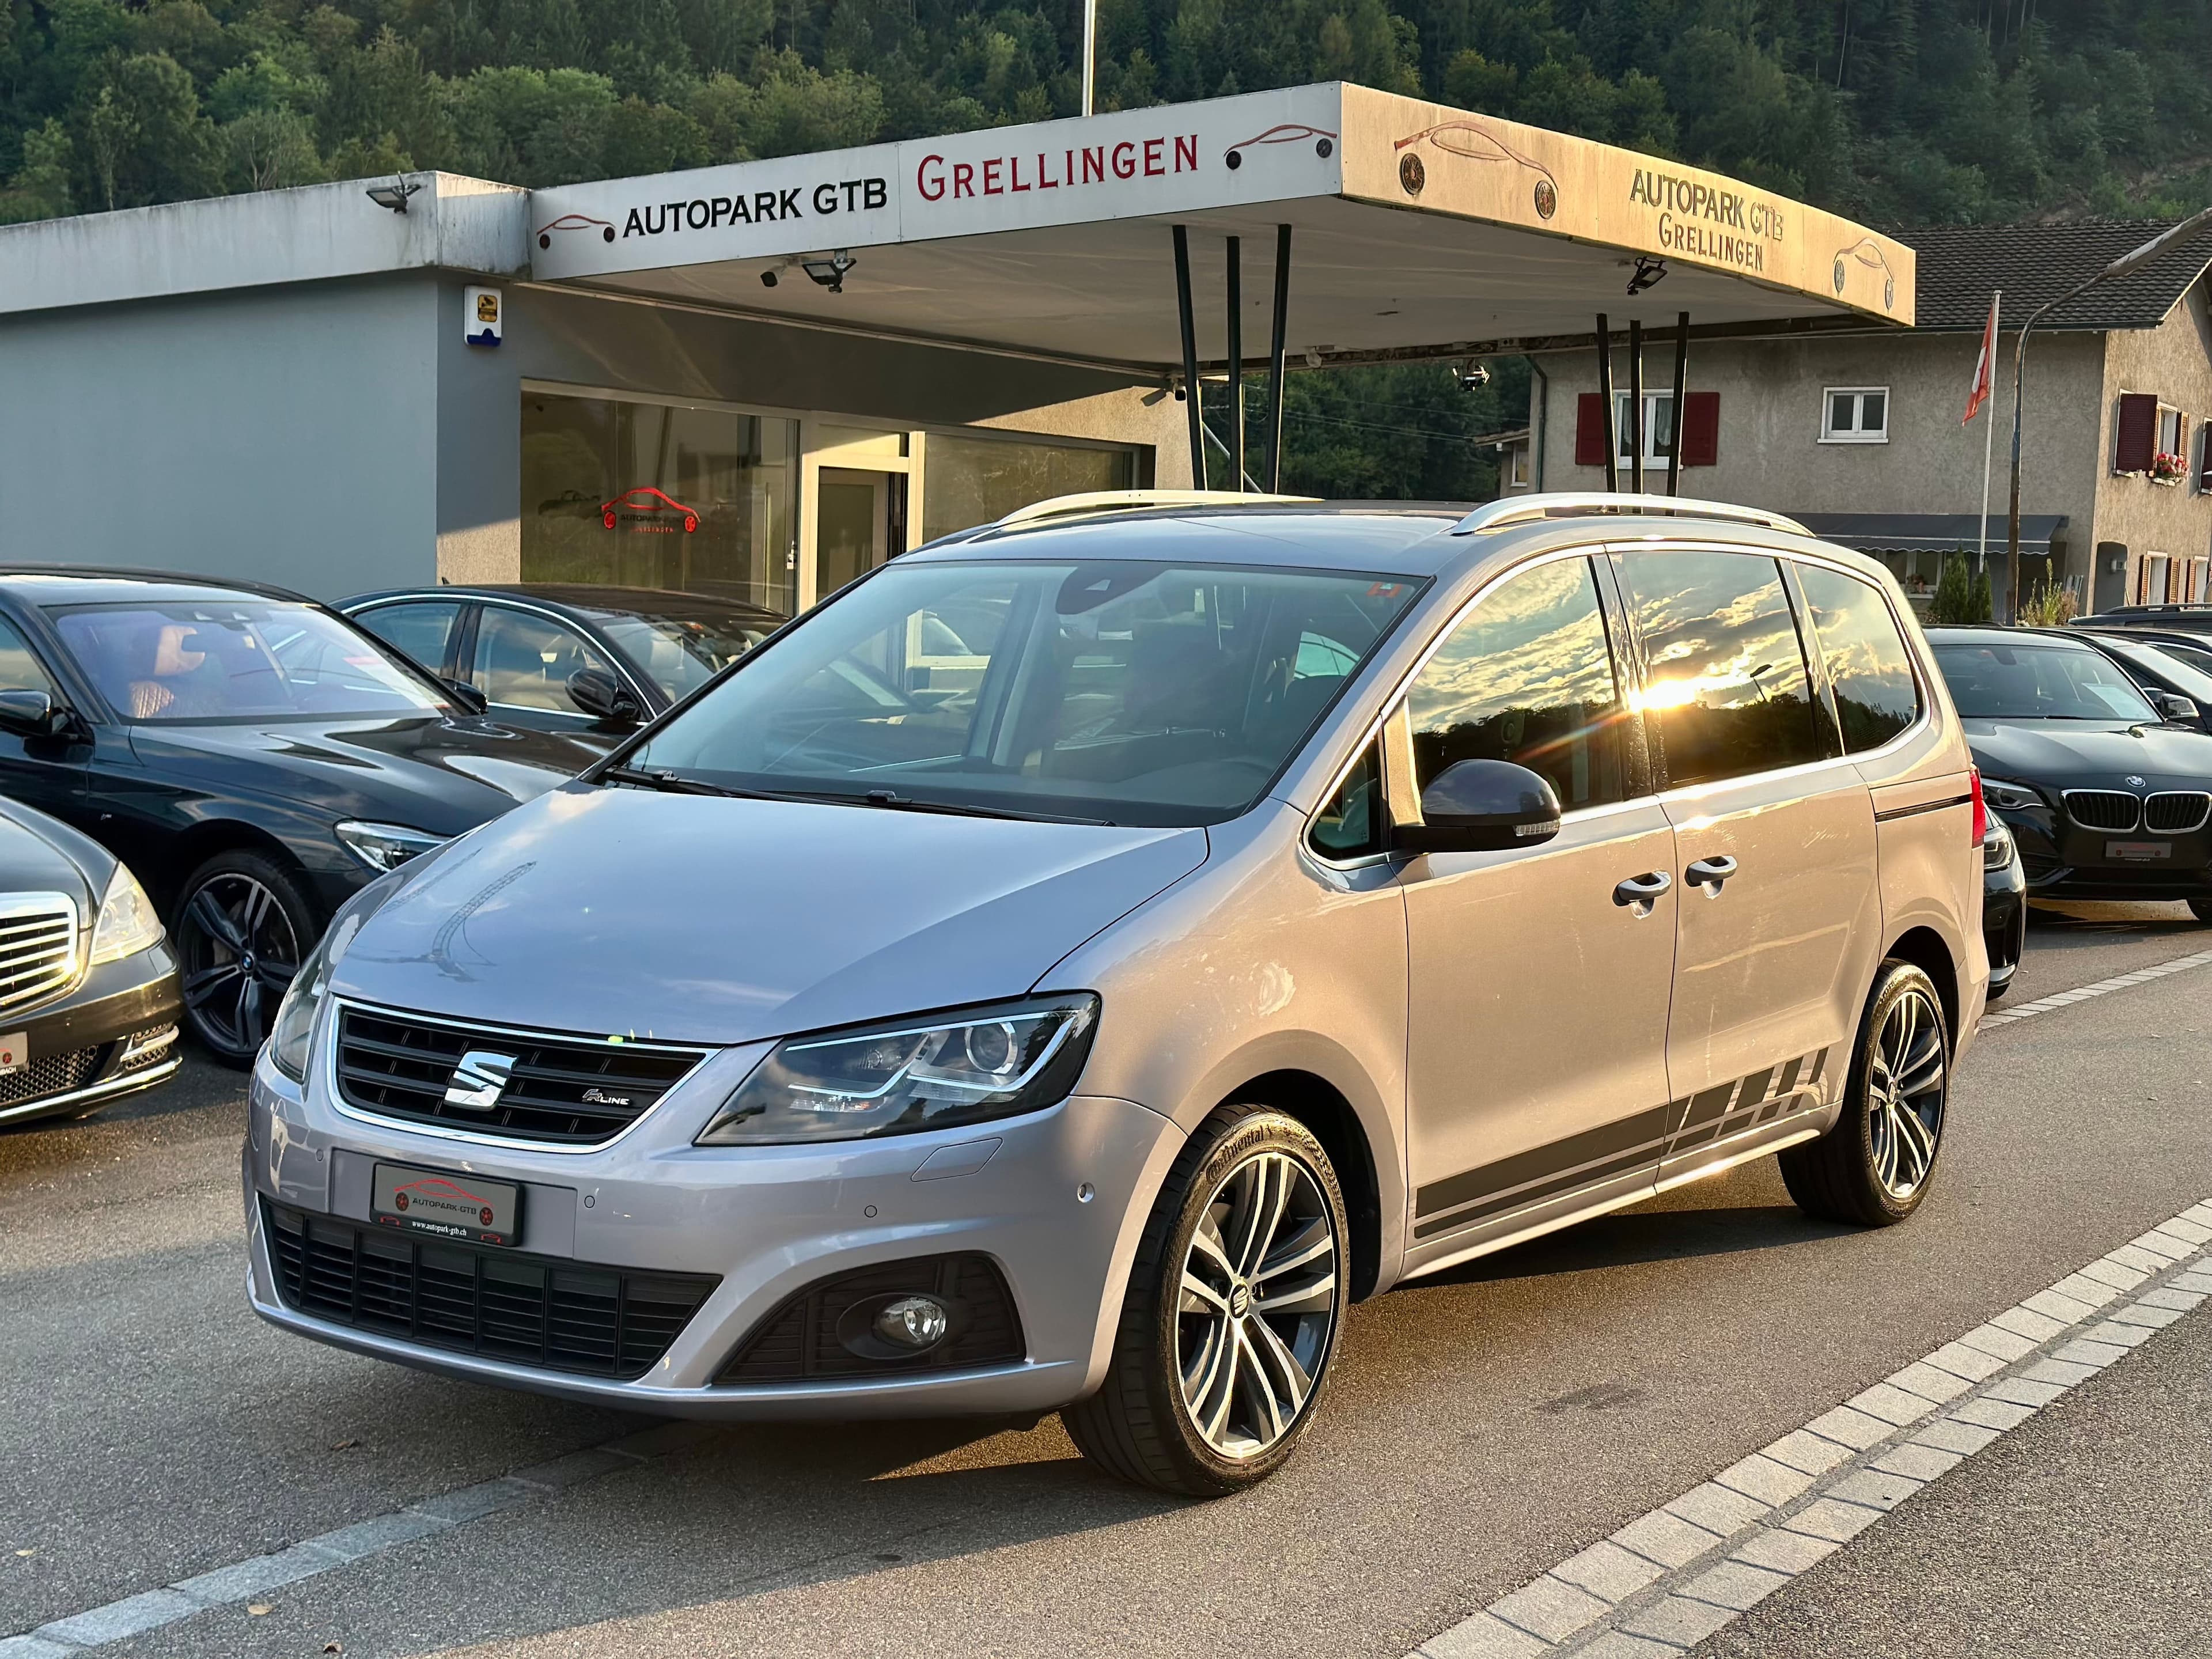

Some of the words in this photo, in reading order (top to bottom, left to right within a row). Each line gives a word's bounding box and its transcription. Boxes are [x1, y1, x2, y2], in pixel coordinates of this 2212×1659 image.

[623, 187, 802, 237] AUTOPARK
[813, 177, 887, 215] GTB
[918, 134, 1198, 201] GRELLINGEN
[1629, 168, 1745, 230] AUTOPARK
[1750, 202, 1784, 242] GTB
[1659, 212, 1763, 271] GRELLINGEN
[1206, 1124, 1264, 1183] Continental
[412, 1221, 467, 1236] www.autopark-gtb.ch
